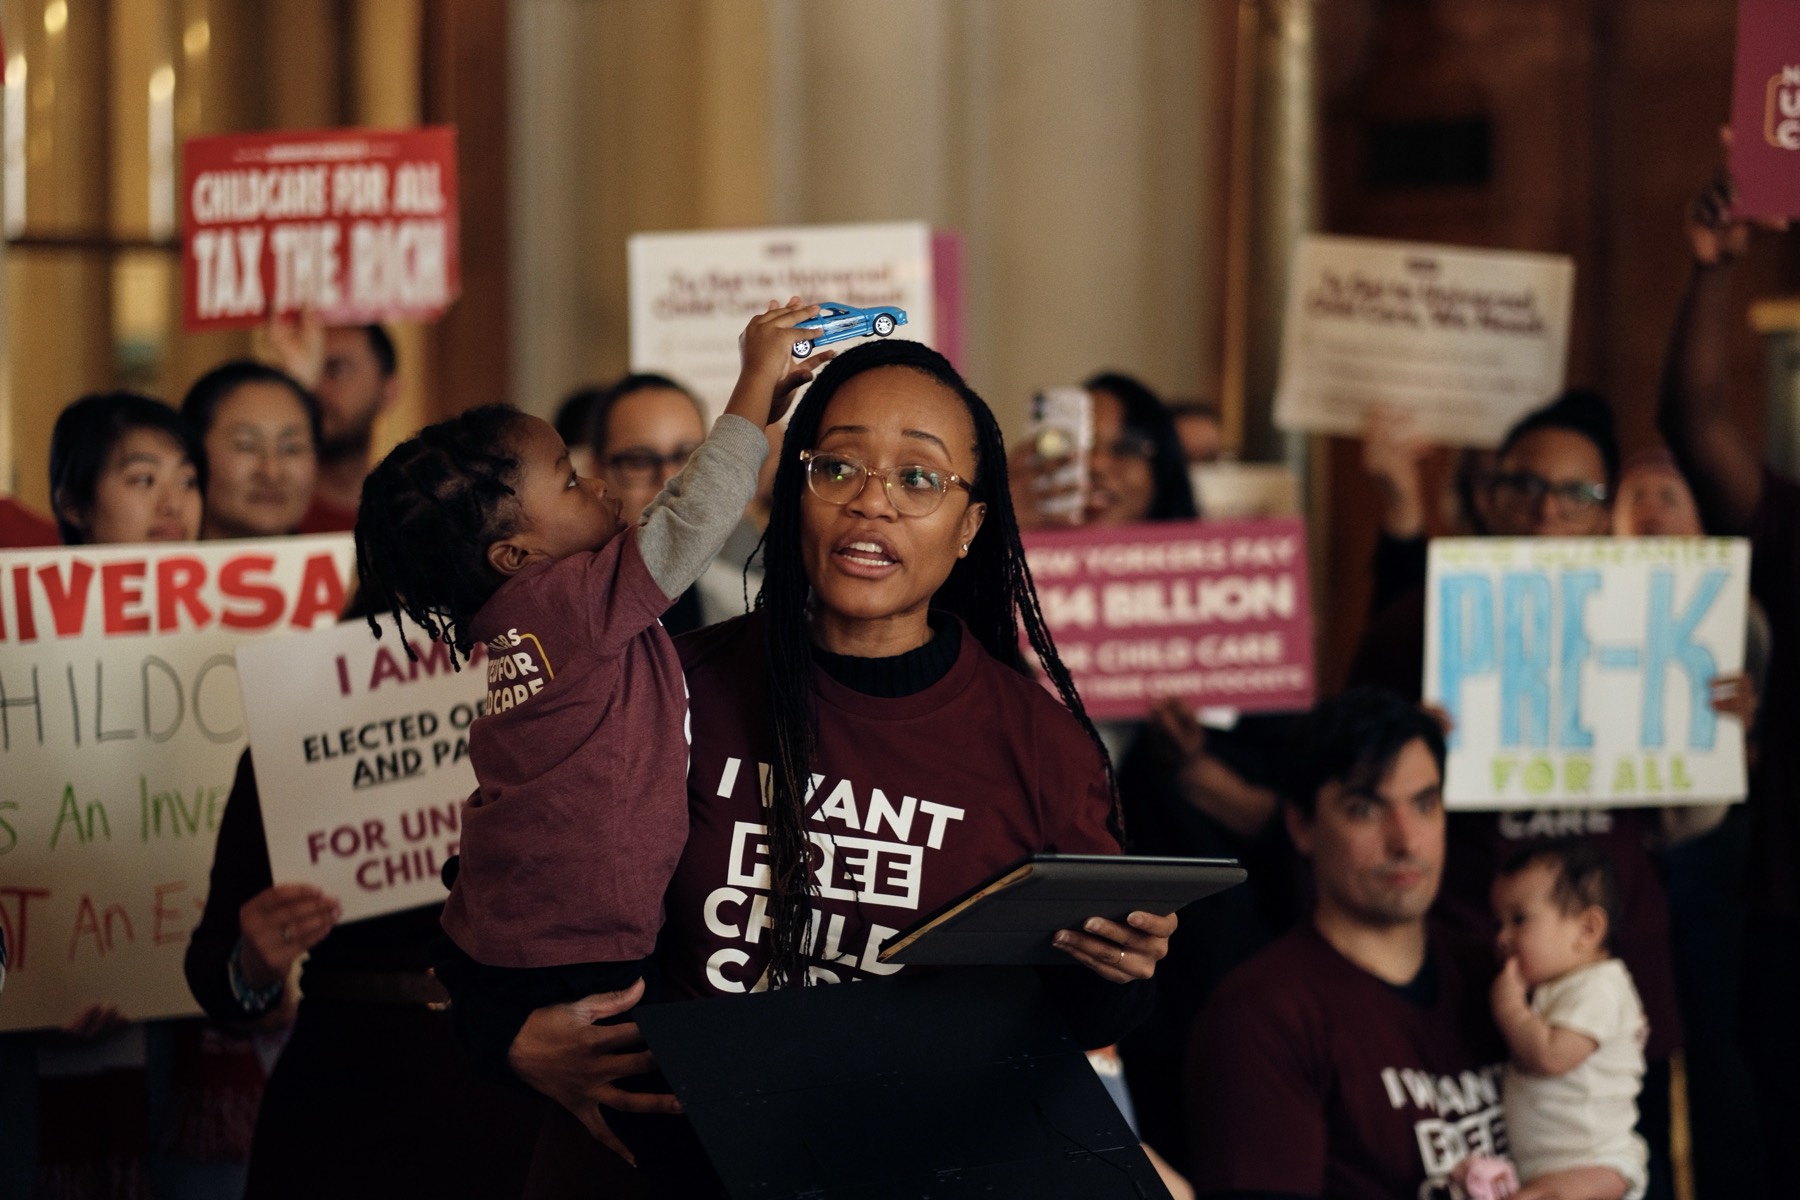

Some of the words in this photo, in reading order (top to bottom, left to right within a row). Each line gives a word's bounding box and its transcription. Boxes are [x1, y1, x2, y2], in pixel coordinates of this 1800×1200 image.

[193, 168, 327, 223] CHILDCARE
[332, 164, 387, 214] FOR
[393, 162, 445, 213] ALL
[194, 228, 264, 318] TAX
[271, 222, 341, 312] THE
[350, 218, 446, 308] RICH
[1231, 536, 1295, 565] PAY
[1102, 573, 1297, 628] BILLION
[335, 655, 351, 697] I
[368, 636, 451, 692] AM
[498, 652, 539, 681] FOR
[1196, 630, 1280, 667] CARE
[1439, 569, 1728, 752] PRE-K
[303, 711, 438, 763] ELECTED
[353, 749, 422, 788] AND
[716, 757, 741, 799] I
[1491, 756, 1593, 793] FOR
[1611, 756, 1693, 791] ALL
[307, 820, 385, 864] FOR
[400, 801, 466, 842] UN
[1381, 1066, 1406, 1110] I
